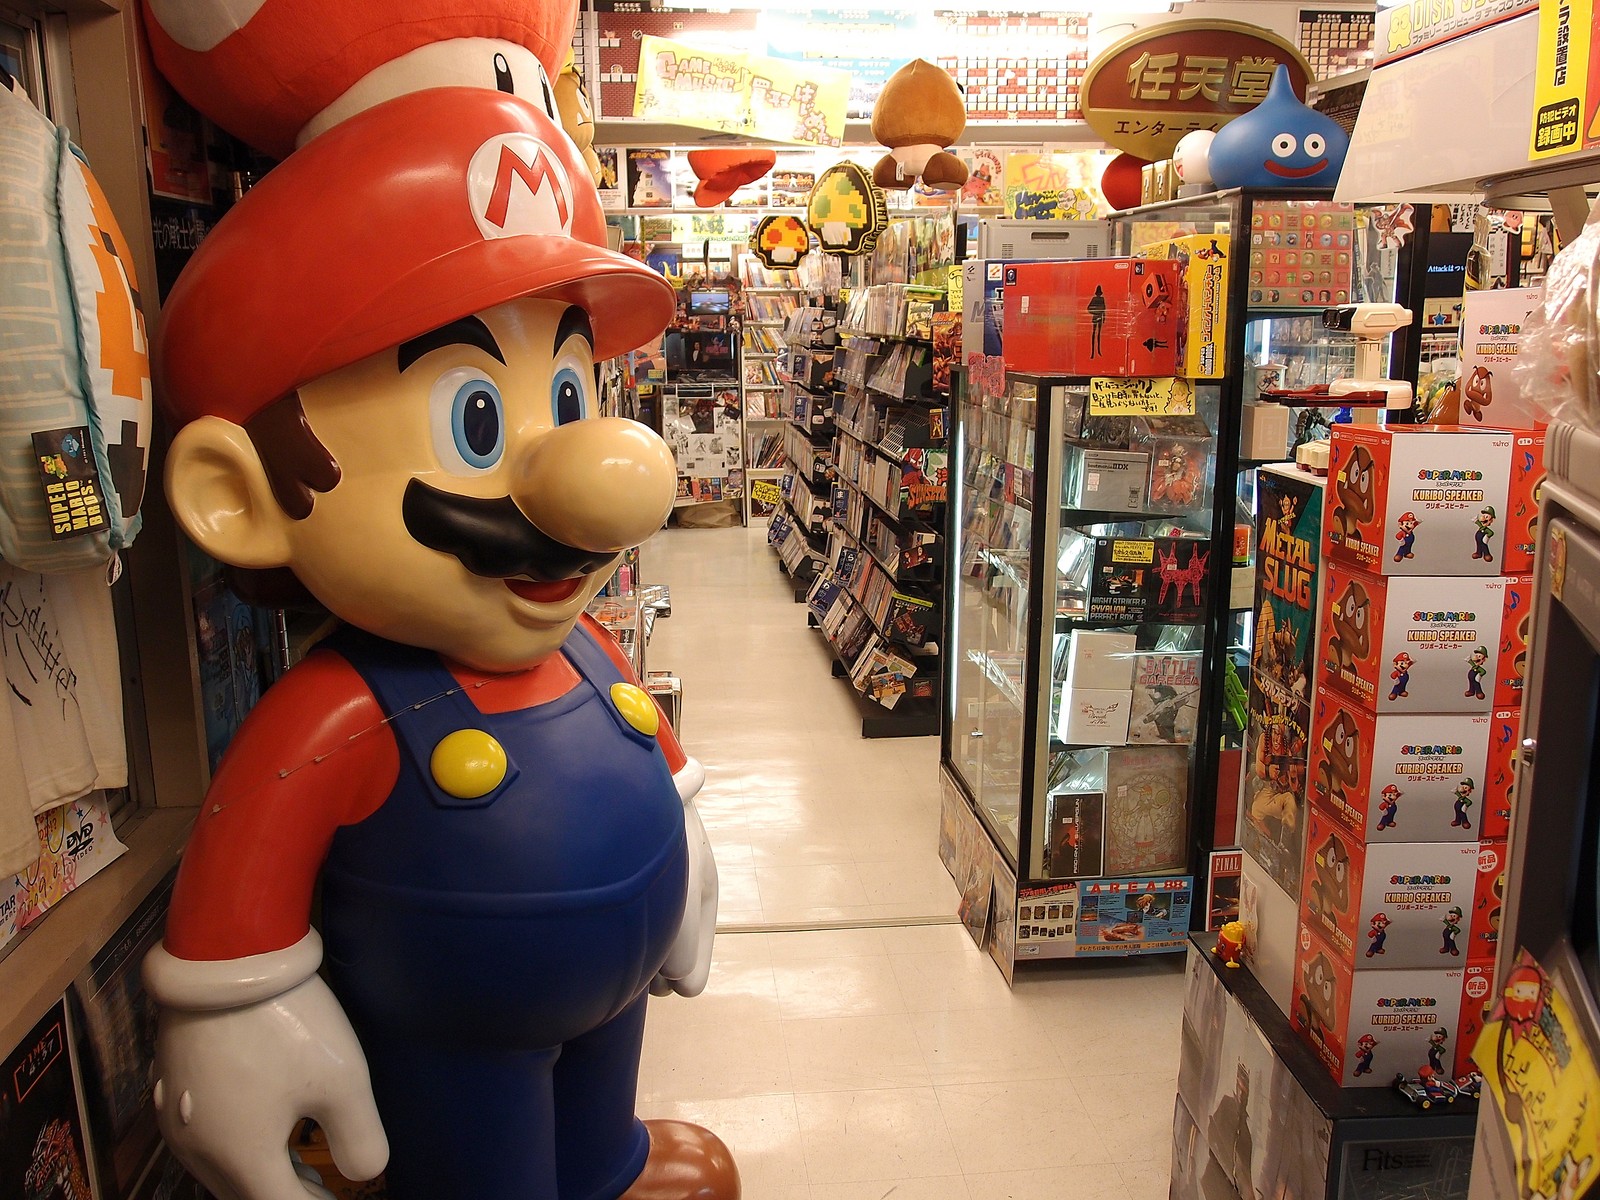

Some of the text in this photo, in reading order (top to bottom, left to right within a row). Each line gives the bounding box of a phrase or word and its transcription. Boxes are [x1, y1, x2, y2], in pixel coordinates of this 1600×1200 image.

[1553, 0, 1570, 88] ラ設置店
[656, 51, 711, 80] GAME
[673, 72, 736, 93] MUSIC
[1126, 51, 1279, 104] 任天堂
[1537, 121, 1577, 147] 録画中
[484, 143, 569, 231] M
[1496, 343, 1518, 355] SPEAKE
[1418, 469, 1483, 481] SUPER MARIO
[1412, 489, 1484, 501] KURIBO SPEAKER
[47, 482, 72, 534] SUPER
[65, 480, 88, 530] MARIO
[80, 479, 103, 527] BROS.
[1260, 517, 1315, 572] METAL
[1360, 542, 1380, 557] SPEAKER
[1263, 556, 1312, 611] SLUG
[1413, 611, 1476, 621] SUPER MARIO
[1407, 630, 1476, 641] KURIBO SPEAKER
[1145, 659, 1197, 676] BATTLE
[1139, 674, 1200, 686] GAREGGA
[1401, 744, 1463, 755] SUPER MARIO
[1396, 763, 1463, 774] KURIBO SPEAKER
[66, 822, 94, 850] DVD
[1215, 857, 1239, 872] FINAL
[1089, 879, 1185, 895] AREA 88
[1390, 875, 1452, 885] SUPER MARIO
[1384, 892, 1452, 904] KURIBO SPEAKER
[1467, 981, 1487, 990] 新品
[1377, 998, 1437, 1007] SUPER MARIO
[1371, 1014, 1437, 1025] KURIBO SPEAKER
